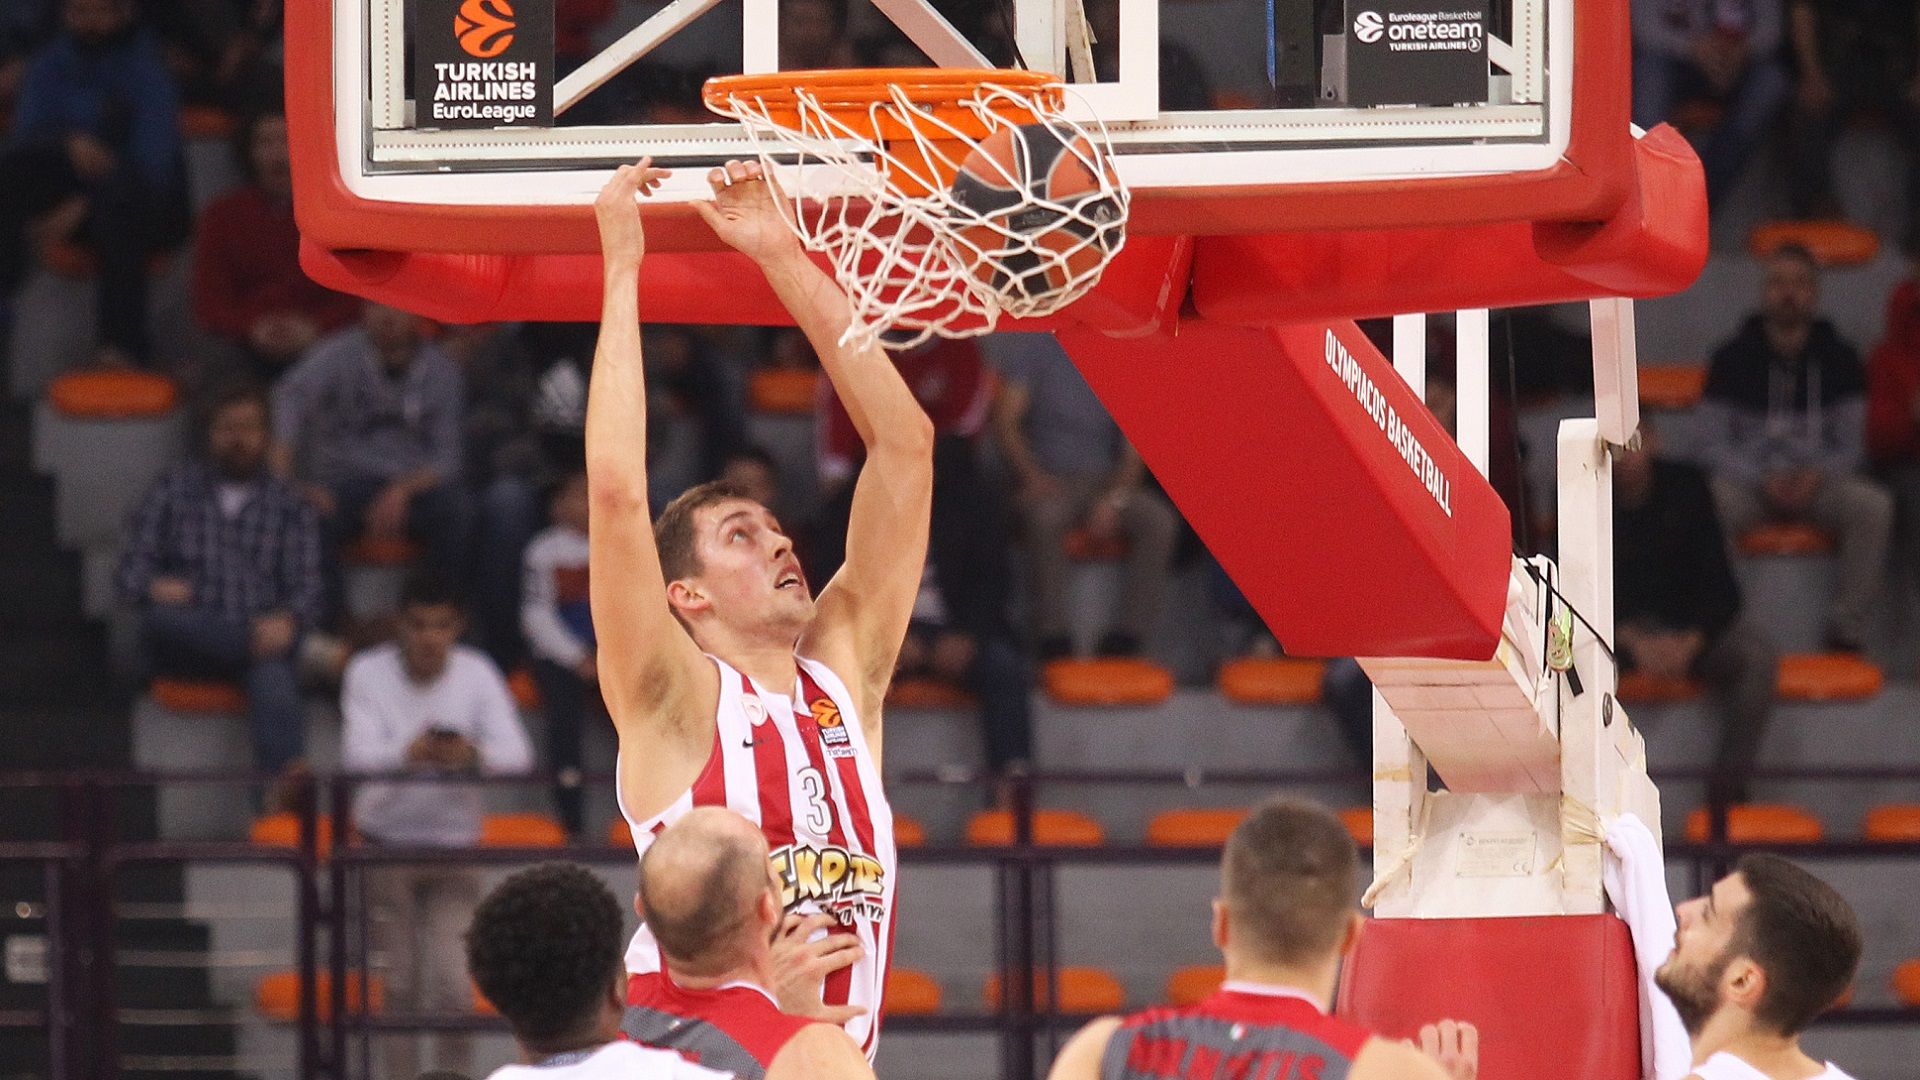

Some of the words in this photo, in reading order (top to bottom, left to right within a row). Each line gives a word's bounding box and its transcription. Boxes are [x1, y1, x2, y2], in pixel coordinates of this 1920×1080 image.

[1388, 12, 1437, 23] Euroleague
[1438, 11, 1482, 20] Basketball
[1388, 21, 1482, 40] oneteam
[1389, 42, 1428, 51] TURKISH
[1429, 41, 1467, 51] AIRLINES
[434, 62, 536, 82] TURKISH
[433, 82, 536, 101] AIRLINES
[432, 102, 536, 123] EuroLeague
[1325, 328, 1386, 431] OLYMPIACOS
[1387, 405, 1452, 518] BASKETBALL
[797, 766, 833, 836] 3
